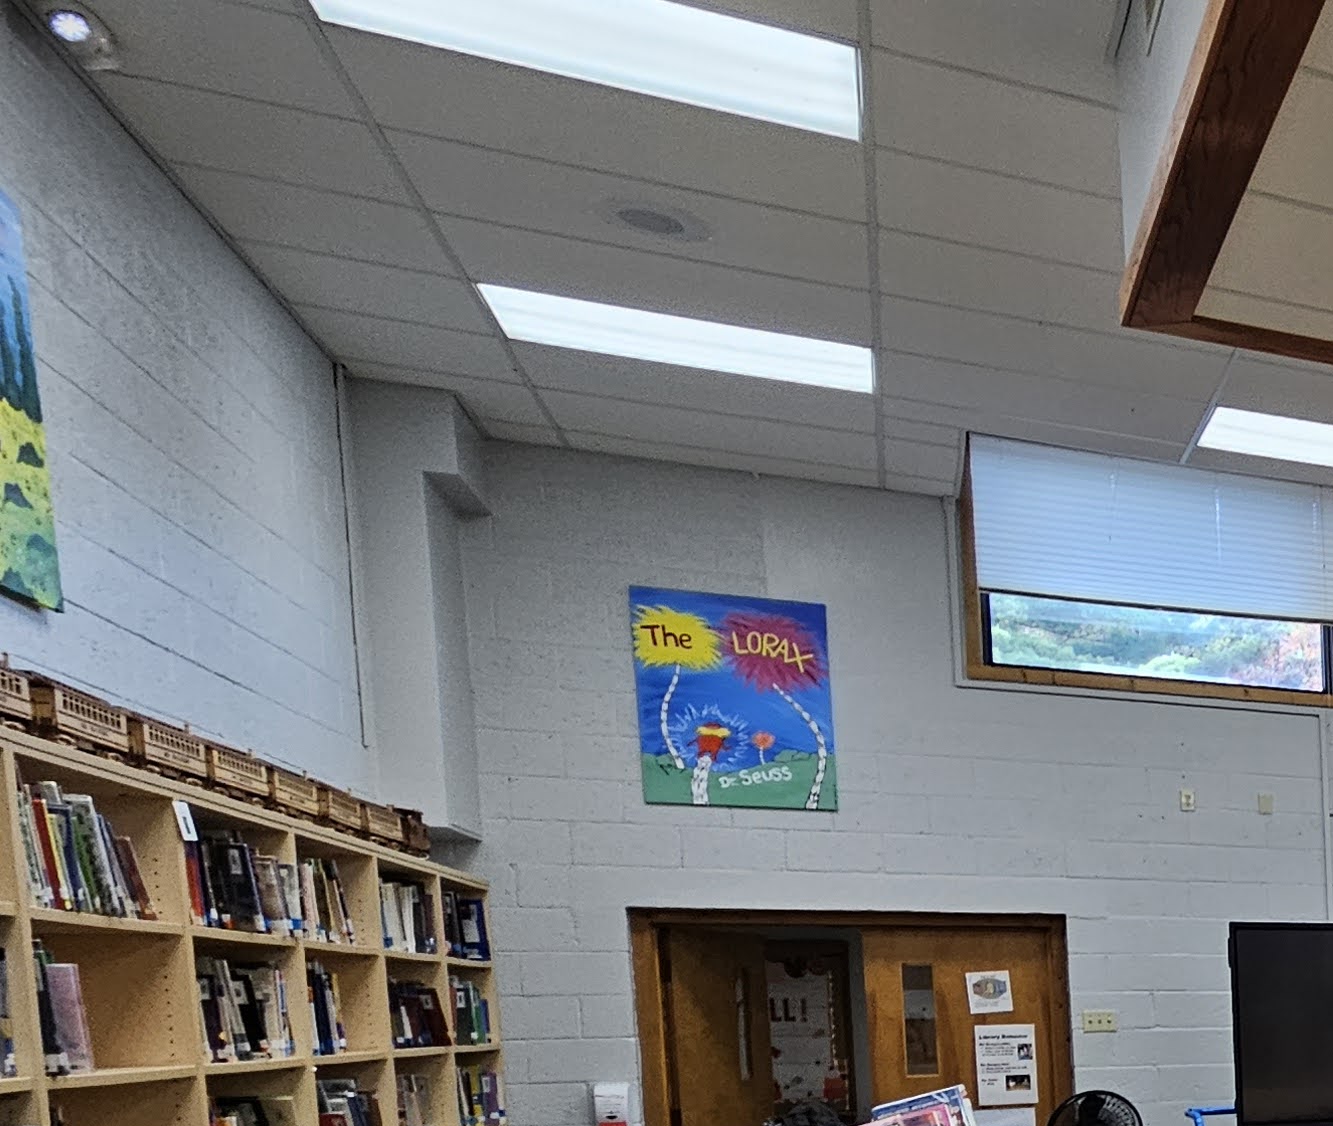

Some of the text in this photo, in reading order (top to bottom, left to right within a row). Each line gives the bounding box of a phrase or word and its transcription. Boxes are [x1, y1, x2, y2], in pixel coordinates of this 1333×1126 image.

[640, 624, 813, 673] The LORAX
[739, 766, 793, 786] Seuss
